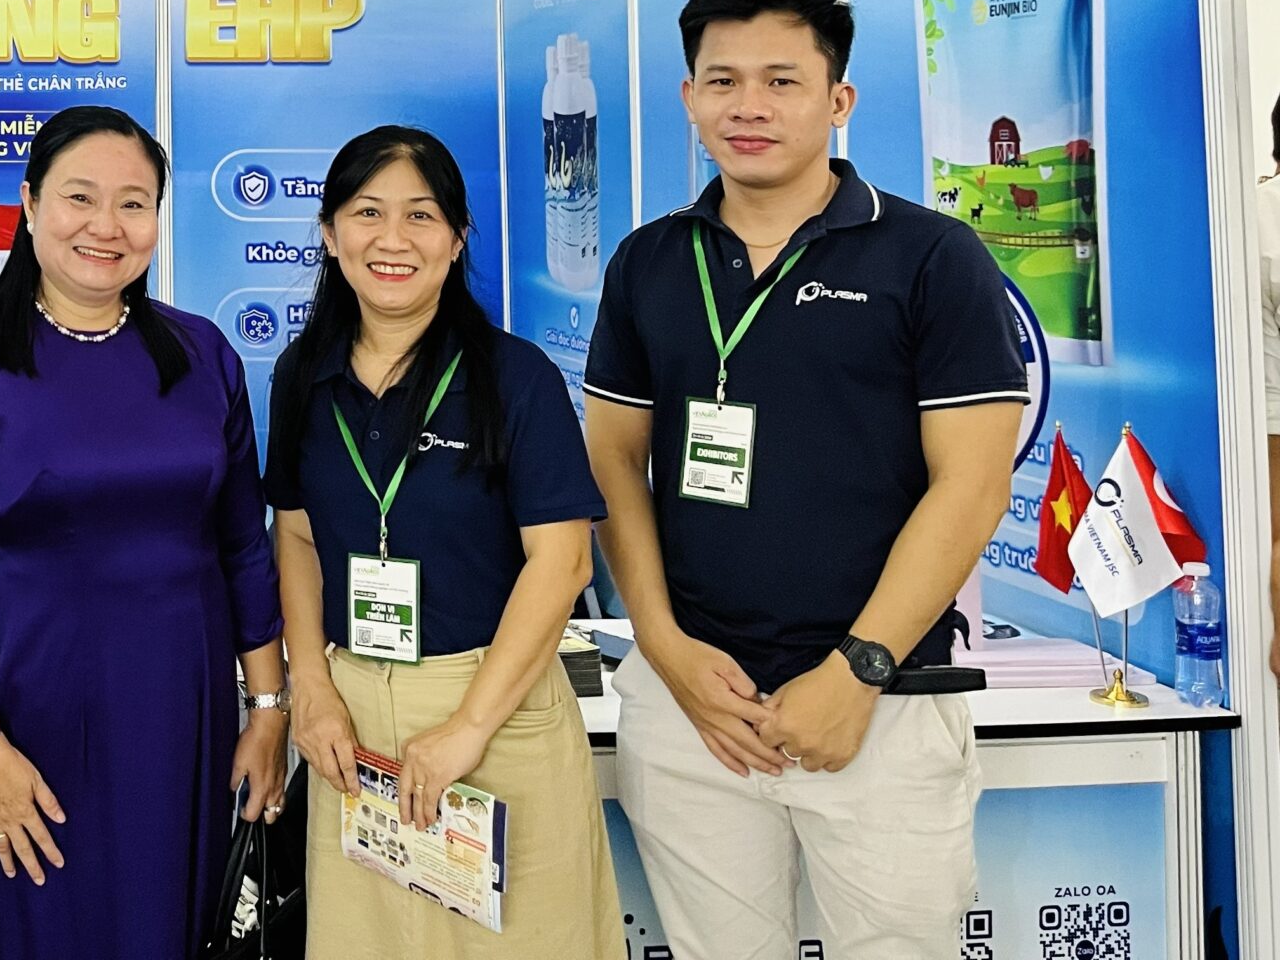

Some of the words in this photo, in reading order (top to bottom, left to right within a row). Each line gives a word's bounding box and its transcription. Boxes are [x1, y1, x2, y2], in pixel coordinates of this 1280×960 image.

[989, 2, 1021, 18] EUNJIN
[27, 74, 71, 90] CHÂN
[75, 71, 127, 89] TRẮNG
[247, 243, 299, 261] Khỏe
[820, 289, 868, 302] PLASMA
[1110, 508, 1144, 566] PLASMA
[1087, 524, 1112, 563] VIETNAM
[1104, 562, 1120, 578] JSC
[1054, 886, 1091, 898] ZALO
[1097, 885, 1116, 896] OA
